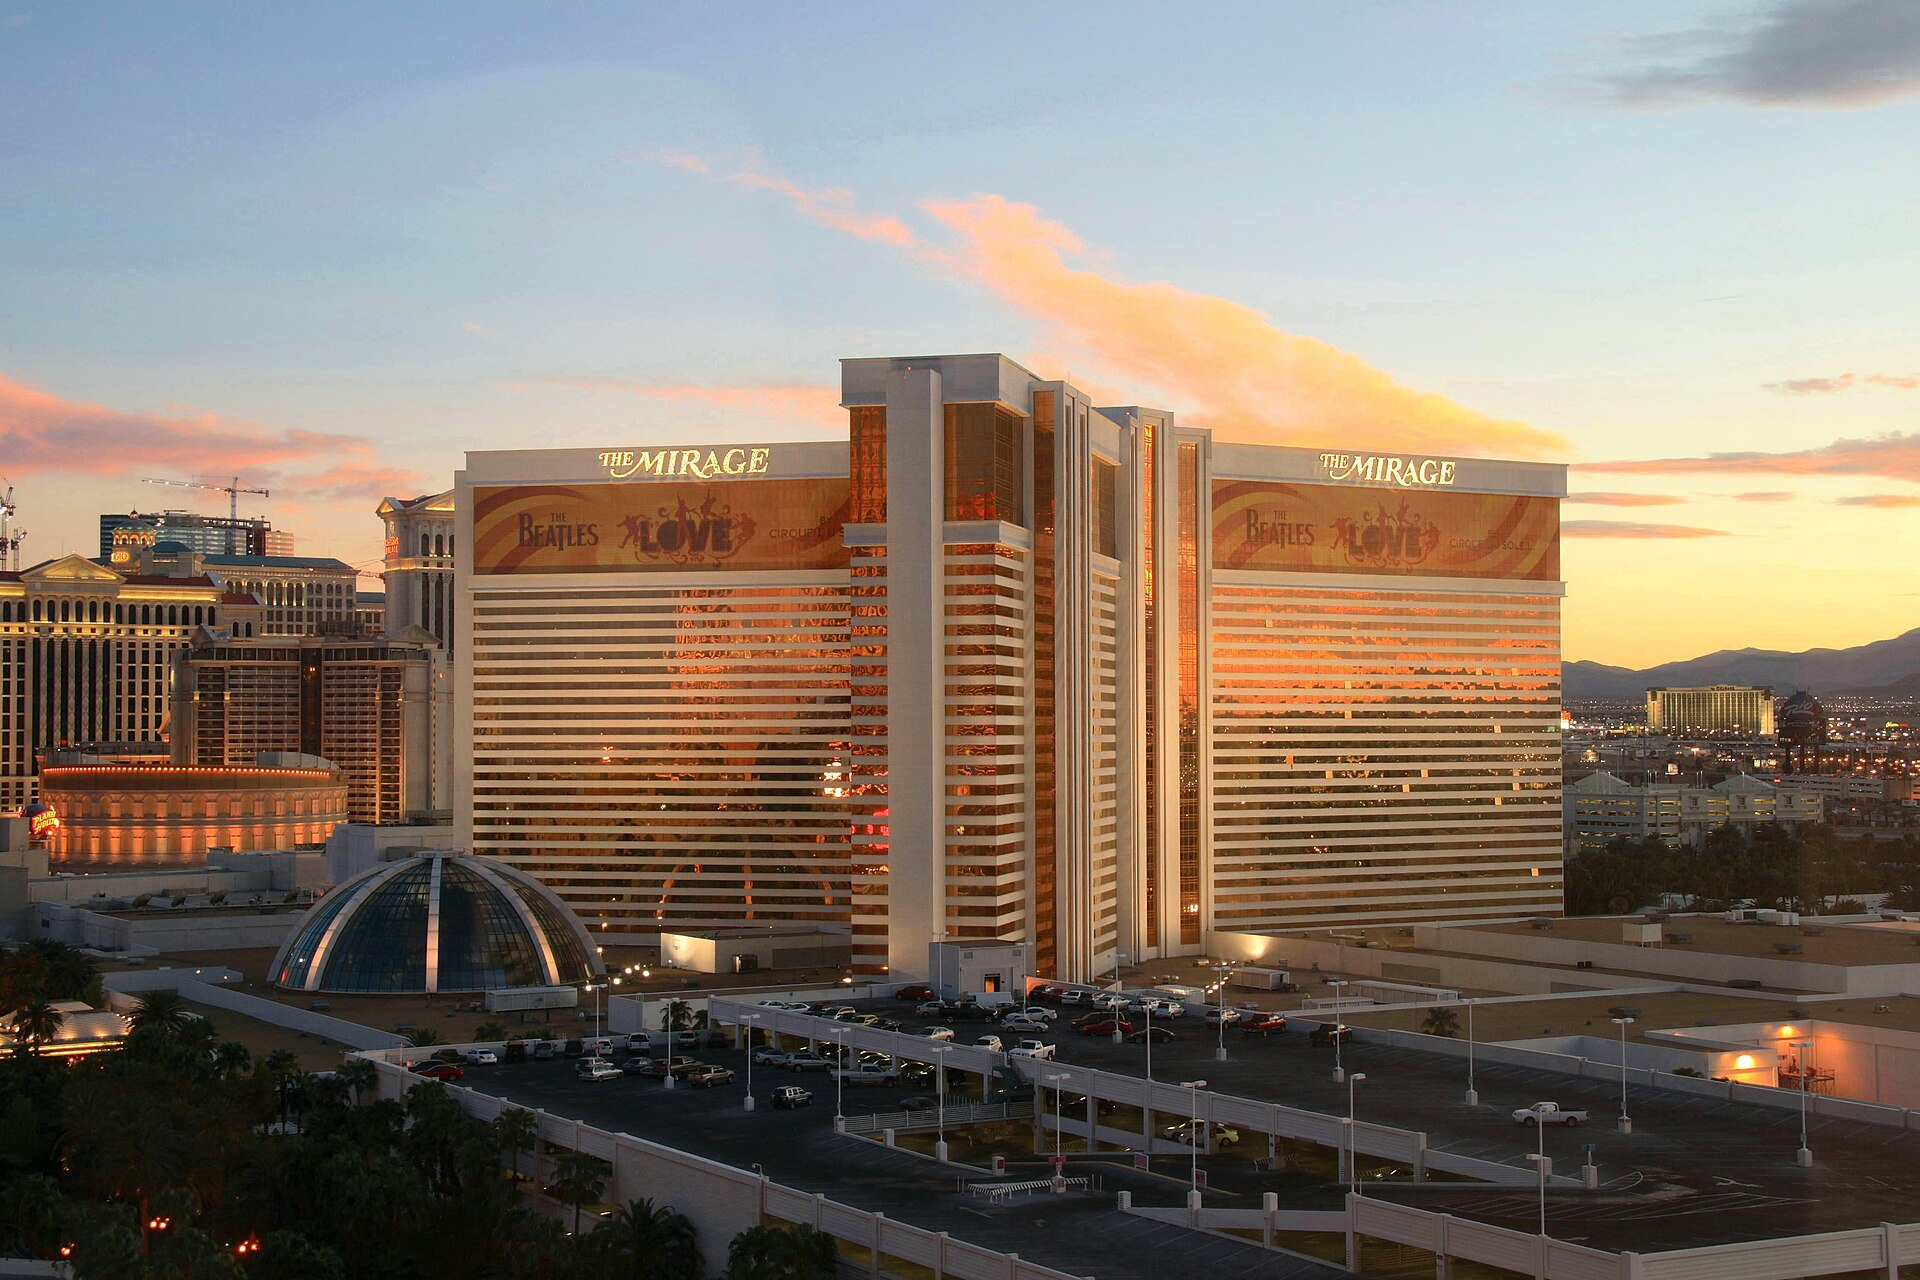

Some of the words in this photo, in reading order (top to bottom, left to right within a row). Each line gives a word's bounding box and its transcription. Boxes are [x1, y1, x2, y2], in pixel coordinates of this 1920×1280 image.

[599, 451, 634, 467] THE
[610, 448, 770, 479] MIRAGE
[1320, 454, 1349, 469] THE
[1329, 455, 1456, 487] MIRAGE
[551, 512, 567, 522] THE
[1274, 510, 1288, 521] THE
[518, 513, 599, 551] BEATLES
[640, 518, 733, 553] LOVE
[769, 528, 815, 540] CIRQUE
[1245, 509, 1315, 549] BEATLES
[1348, 521, 1422, 557] LOVE
[1502, 541, 1532, 551] SOLEL
